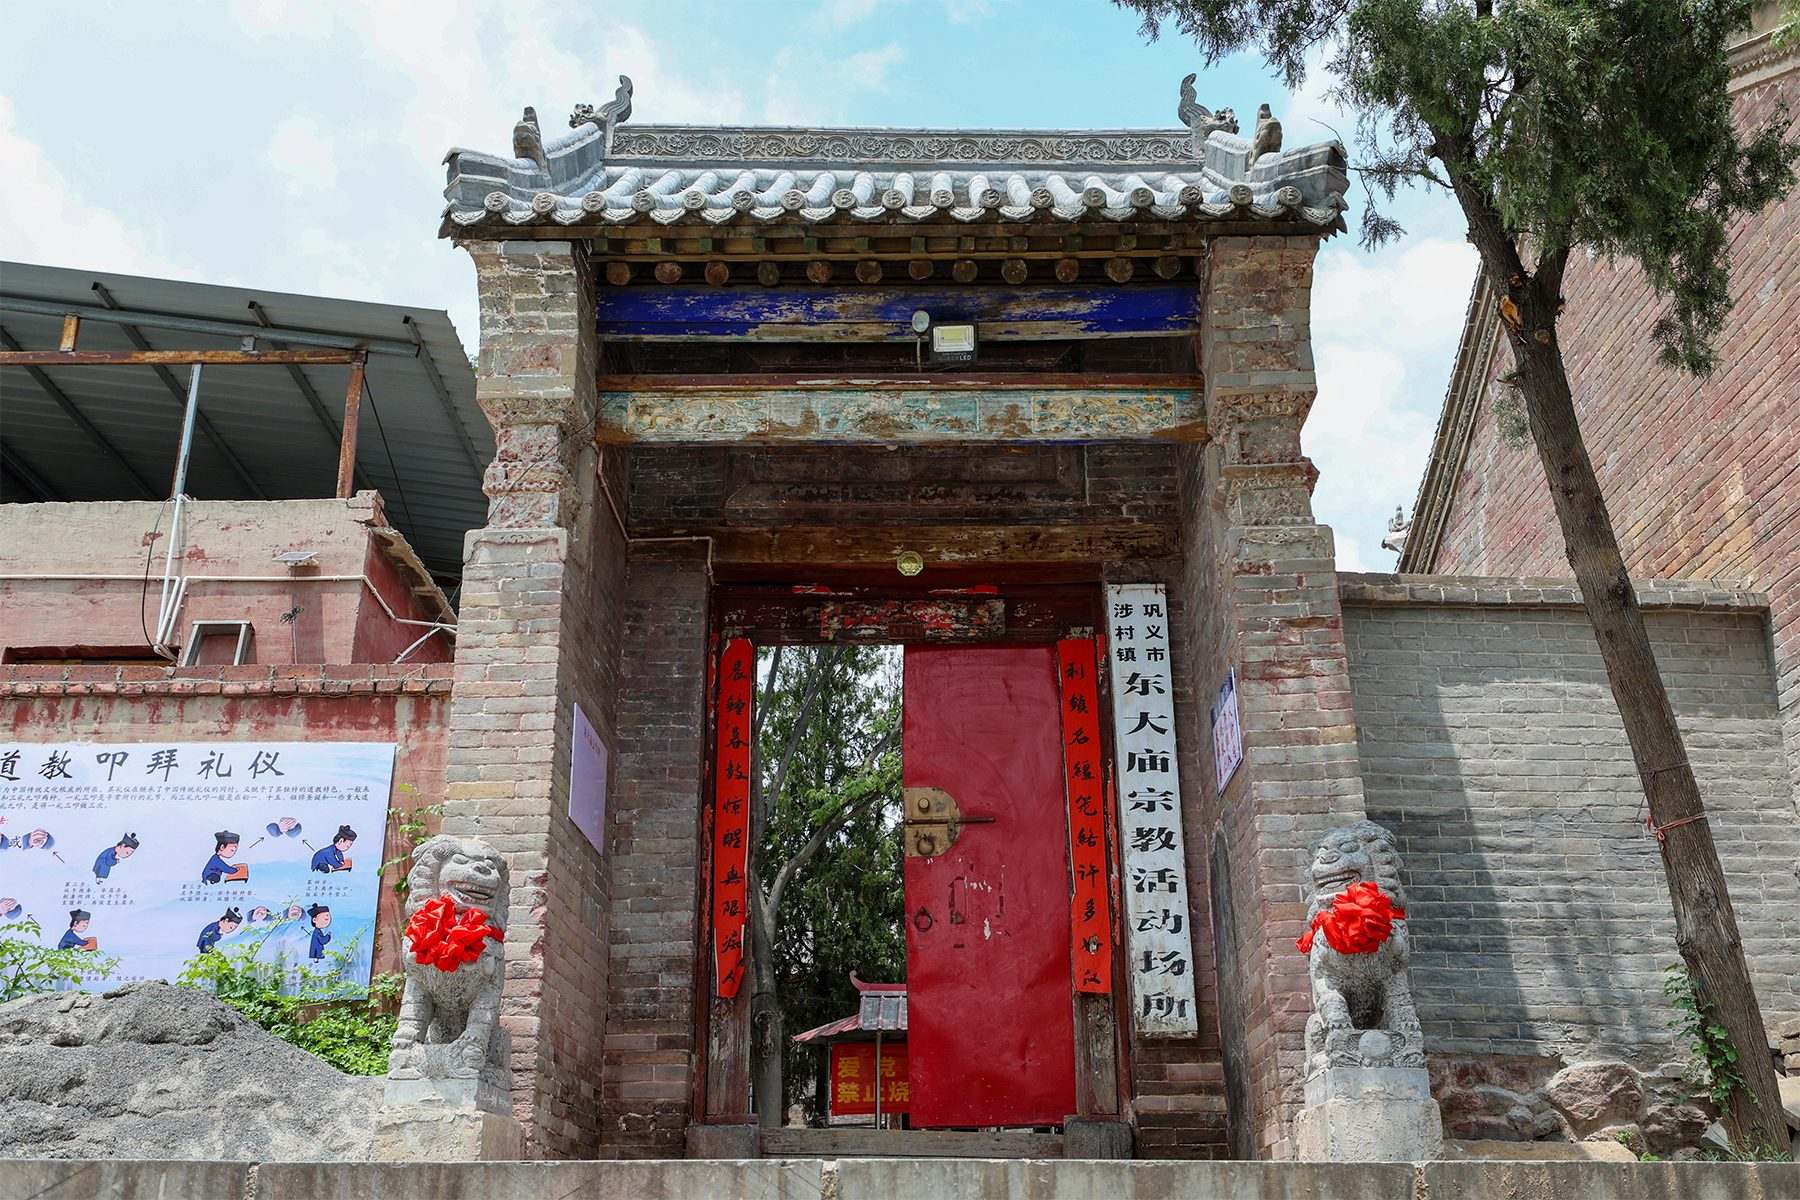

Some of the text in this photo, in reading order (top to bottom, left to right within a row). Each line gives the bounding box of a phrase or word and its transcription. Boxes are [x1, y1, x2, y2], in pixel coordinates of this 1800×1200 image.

[1113, 603, 1137, 664] 涉村镇
[1143, 603, 1165, 663] 巩义市
[0, 748, 285, 782] 道教叩拜礼仪
[9, 834, 22, 848] 或
[1123, 671, 1189, 1019] 东大庙宗教活动场所
